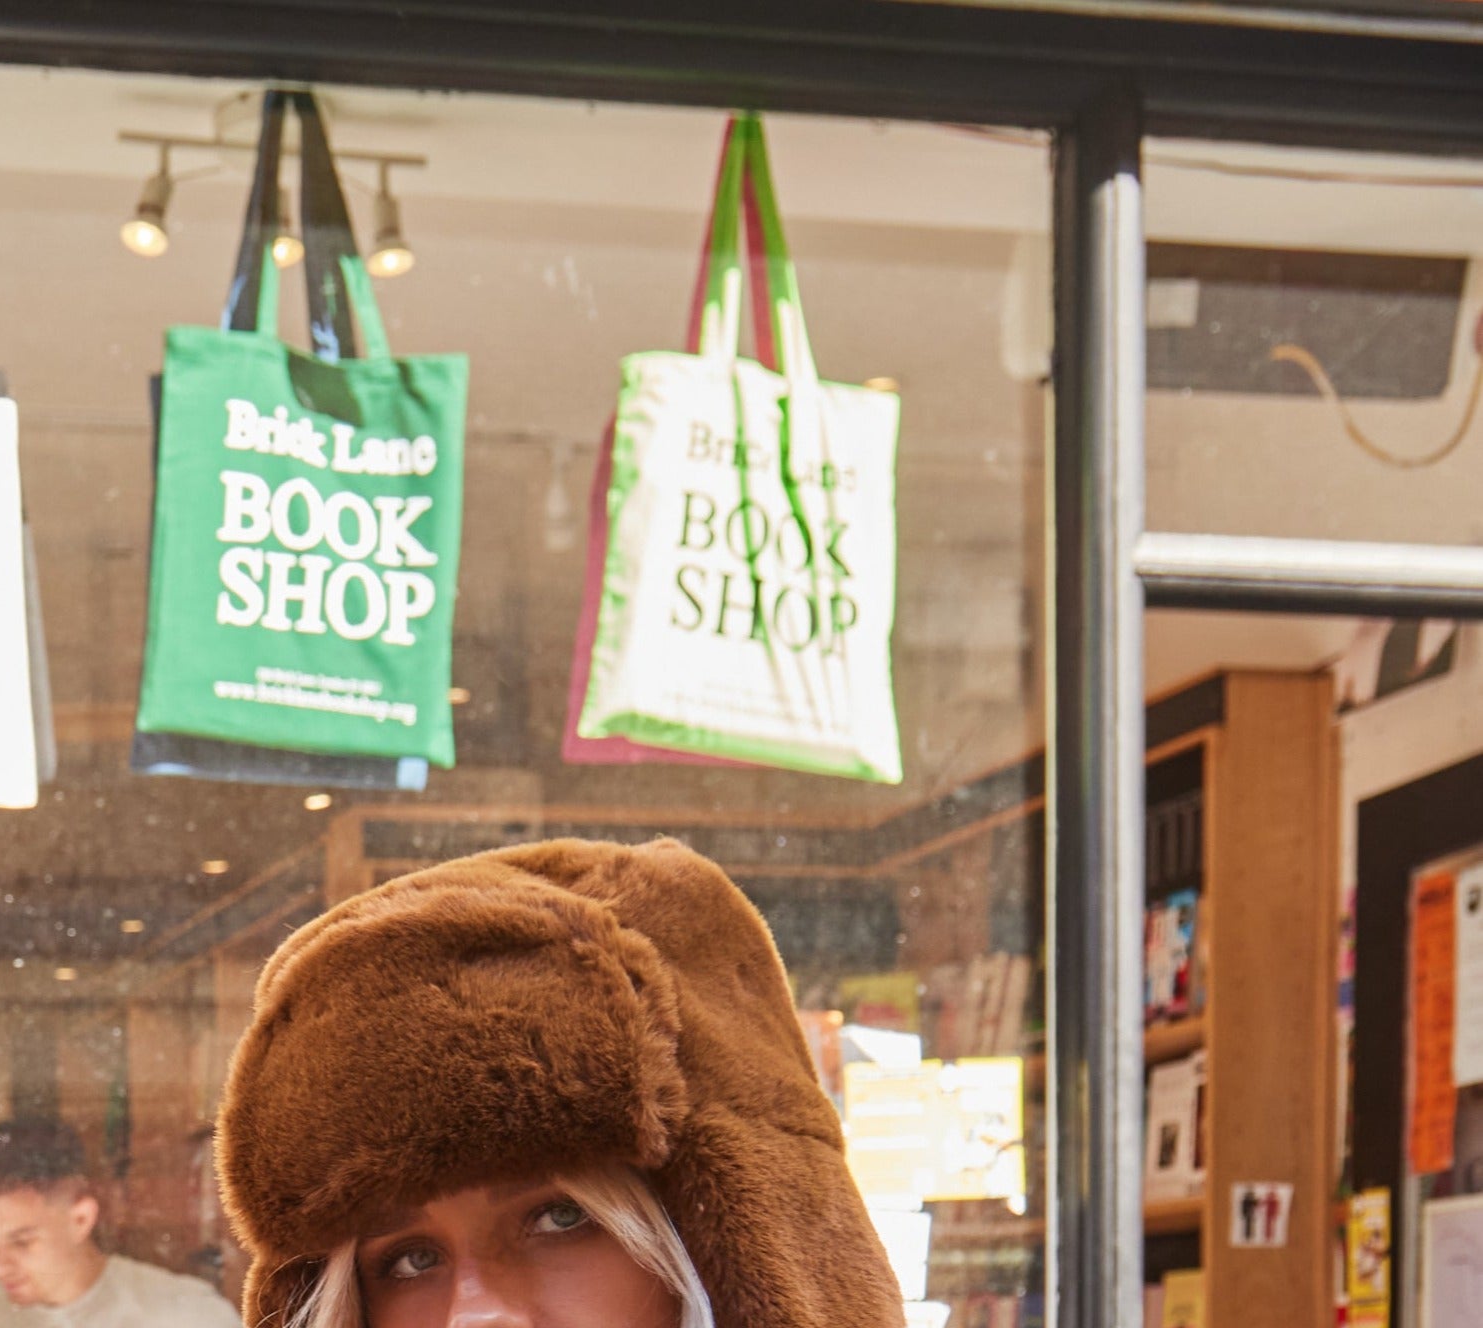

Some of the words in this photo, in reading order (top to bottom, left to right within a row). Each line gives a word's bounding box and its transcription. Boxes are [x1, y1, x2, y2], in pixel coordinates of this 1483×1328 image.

[224, 398, 329, 469] Brick
[331, 422, 438, 477] Lane
[216, 469, 439, 567] BOOK
[676, 491, 853, 580] BOOK
[216, 546, 436, 646] SHOP
[671, 563, 858, 655] SHOP
